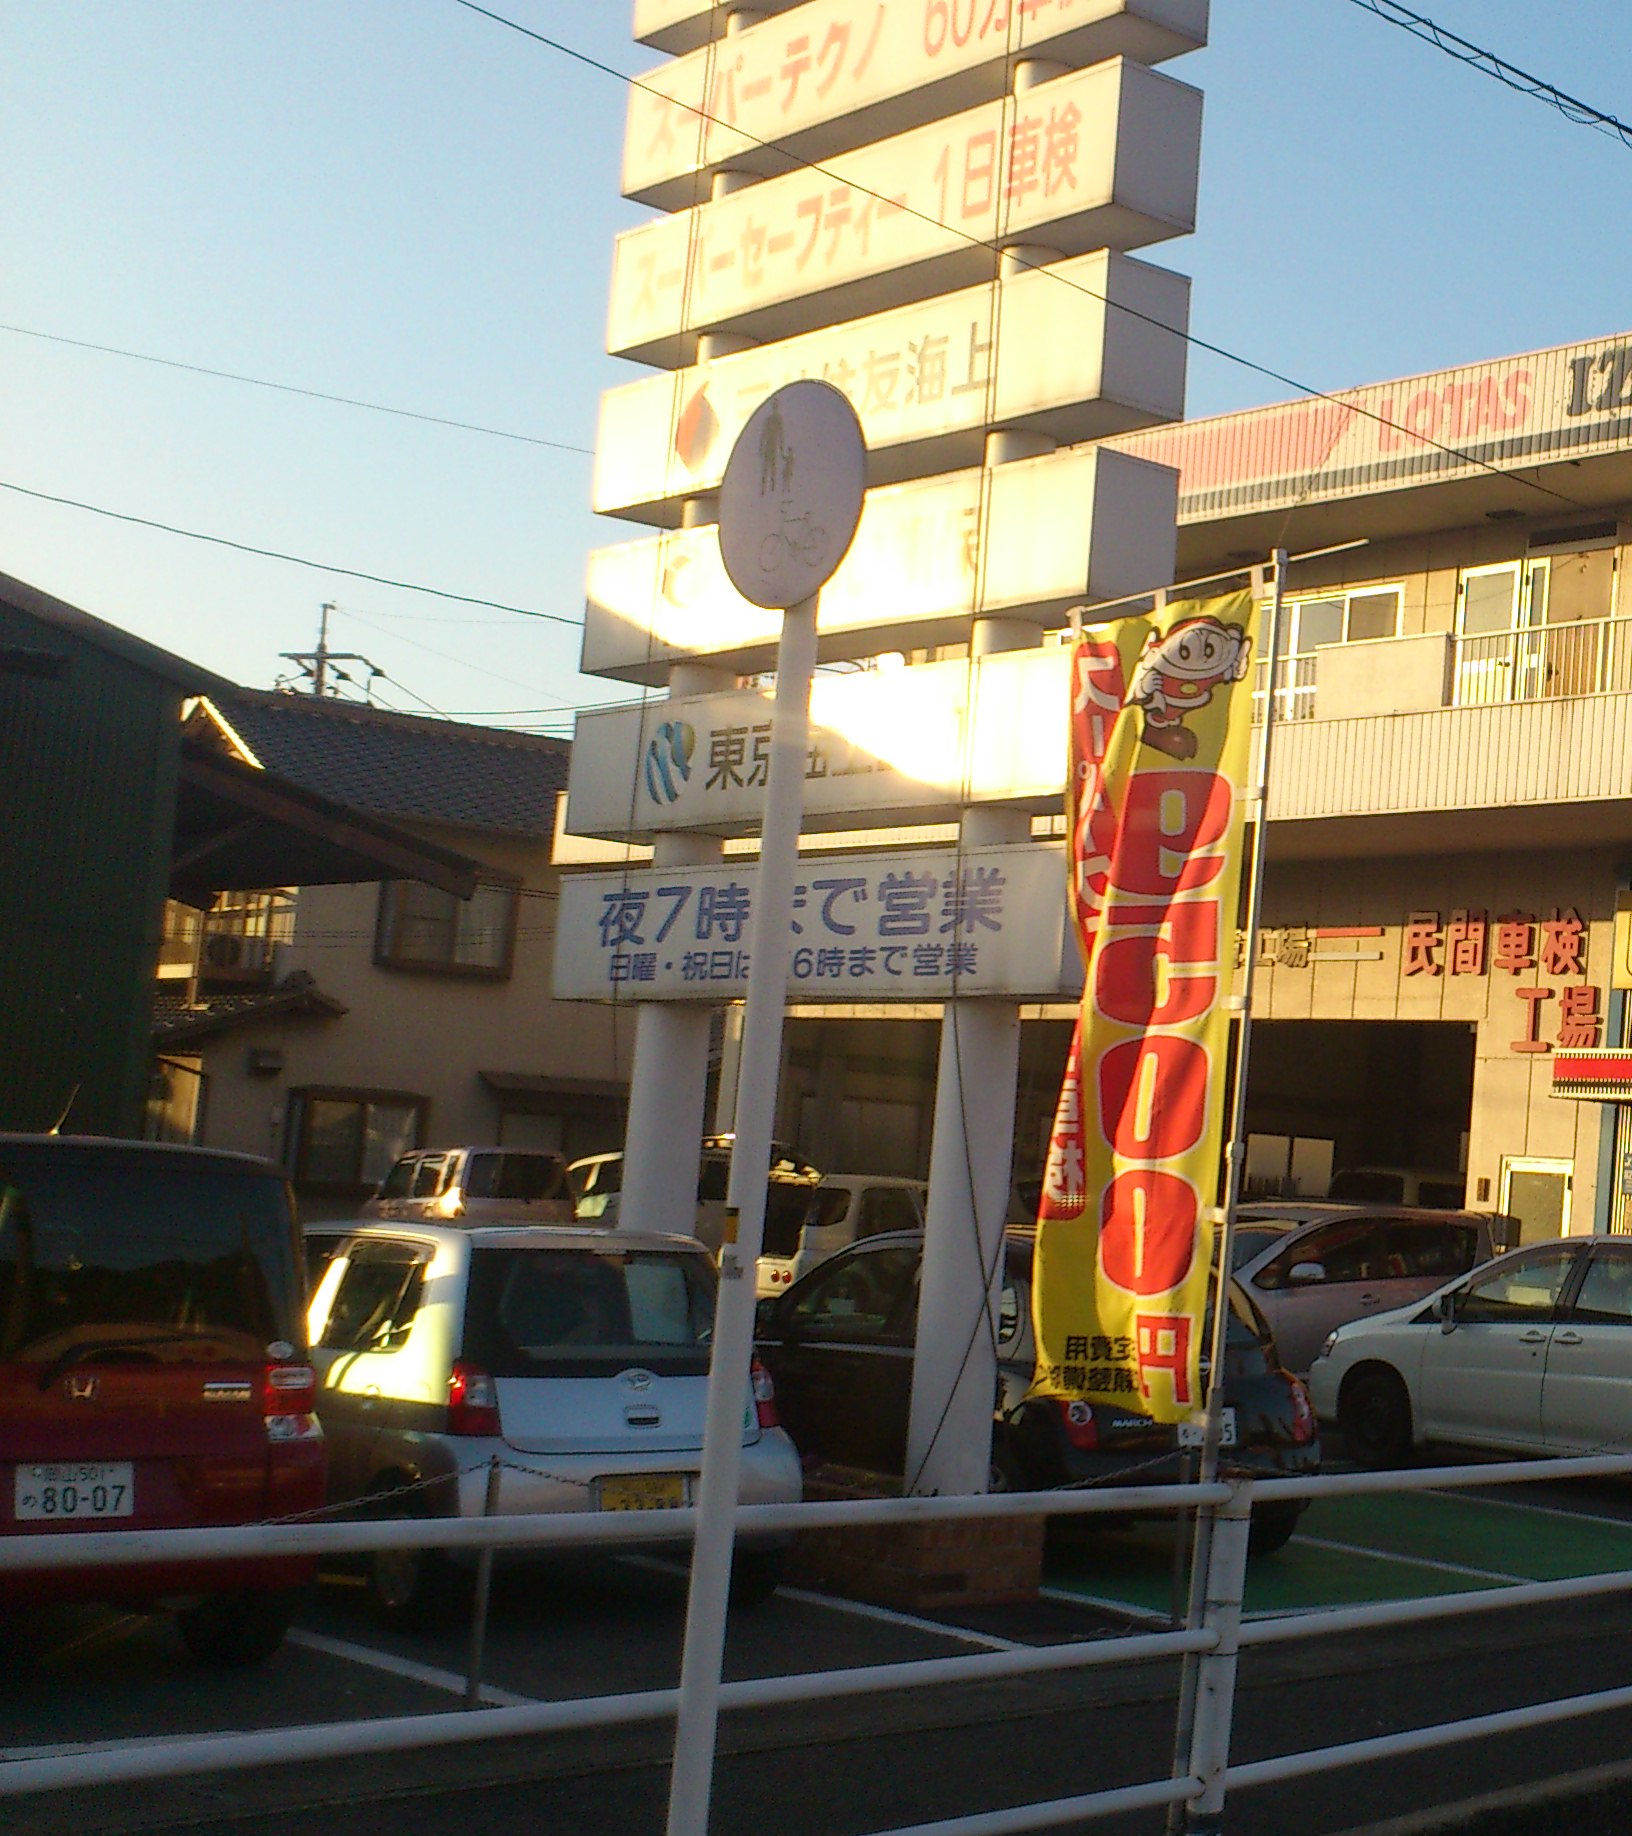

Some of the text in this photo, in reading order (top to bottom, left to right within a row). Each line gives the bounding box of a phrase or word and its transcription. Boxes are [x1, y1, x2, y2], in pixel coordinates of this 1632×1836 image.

[923, 0, 1073, 58] 60万
[934, 100, 1083, 224] 1日車検
[1376, 368, 1535, 455] LOTAS
[598, 866, 1006, 947] 夜7時で営業
[1403, 907, 1586, 977] 民間車検
[1509, 985, 1602, 1054] 工場
[42, 1484, 127, 1514] 80-07
